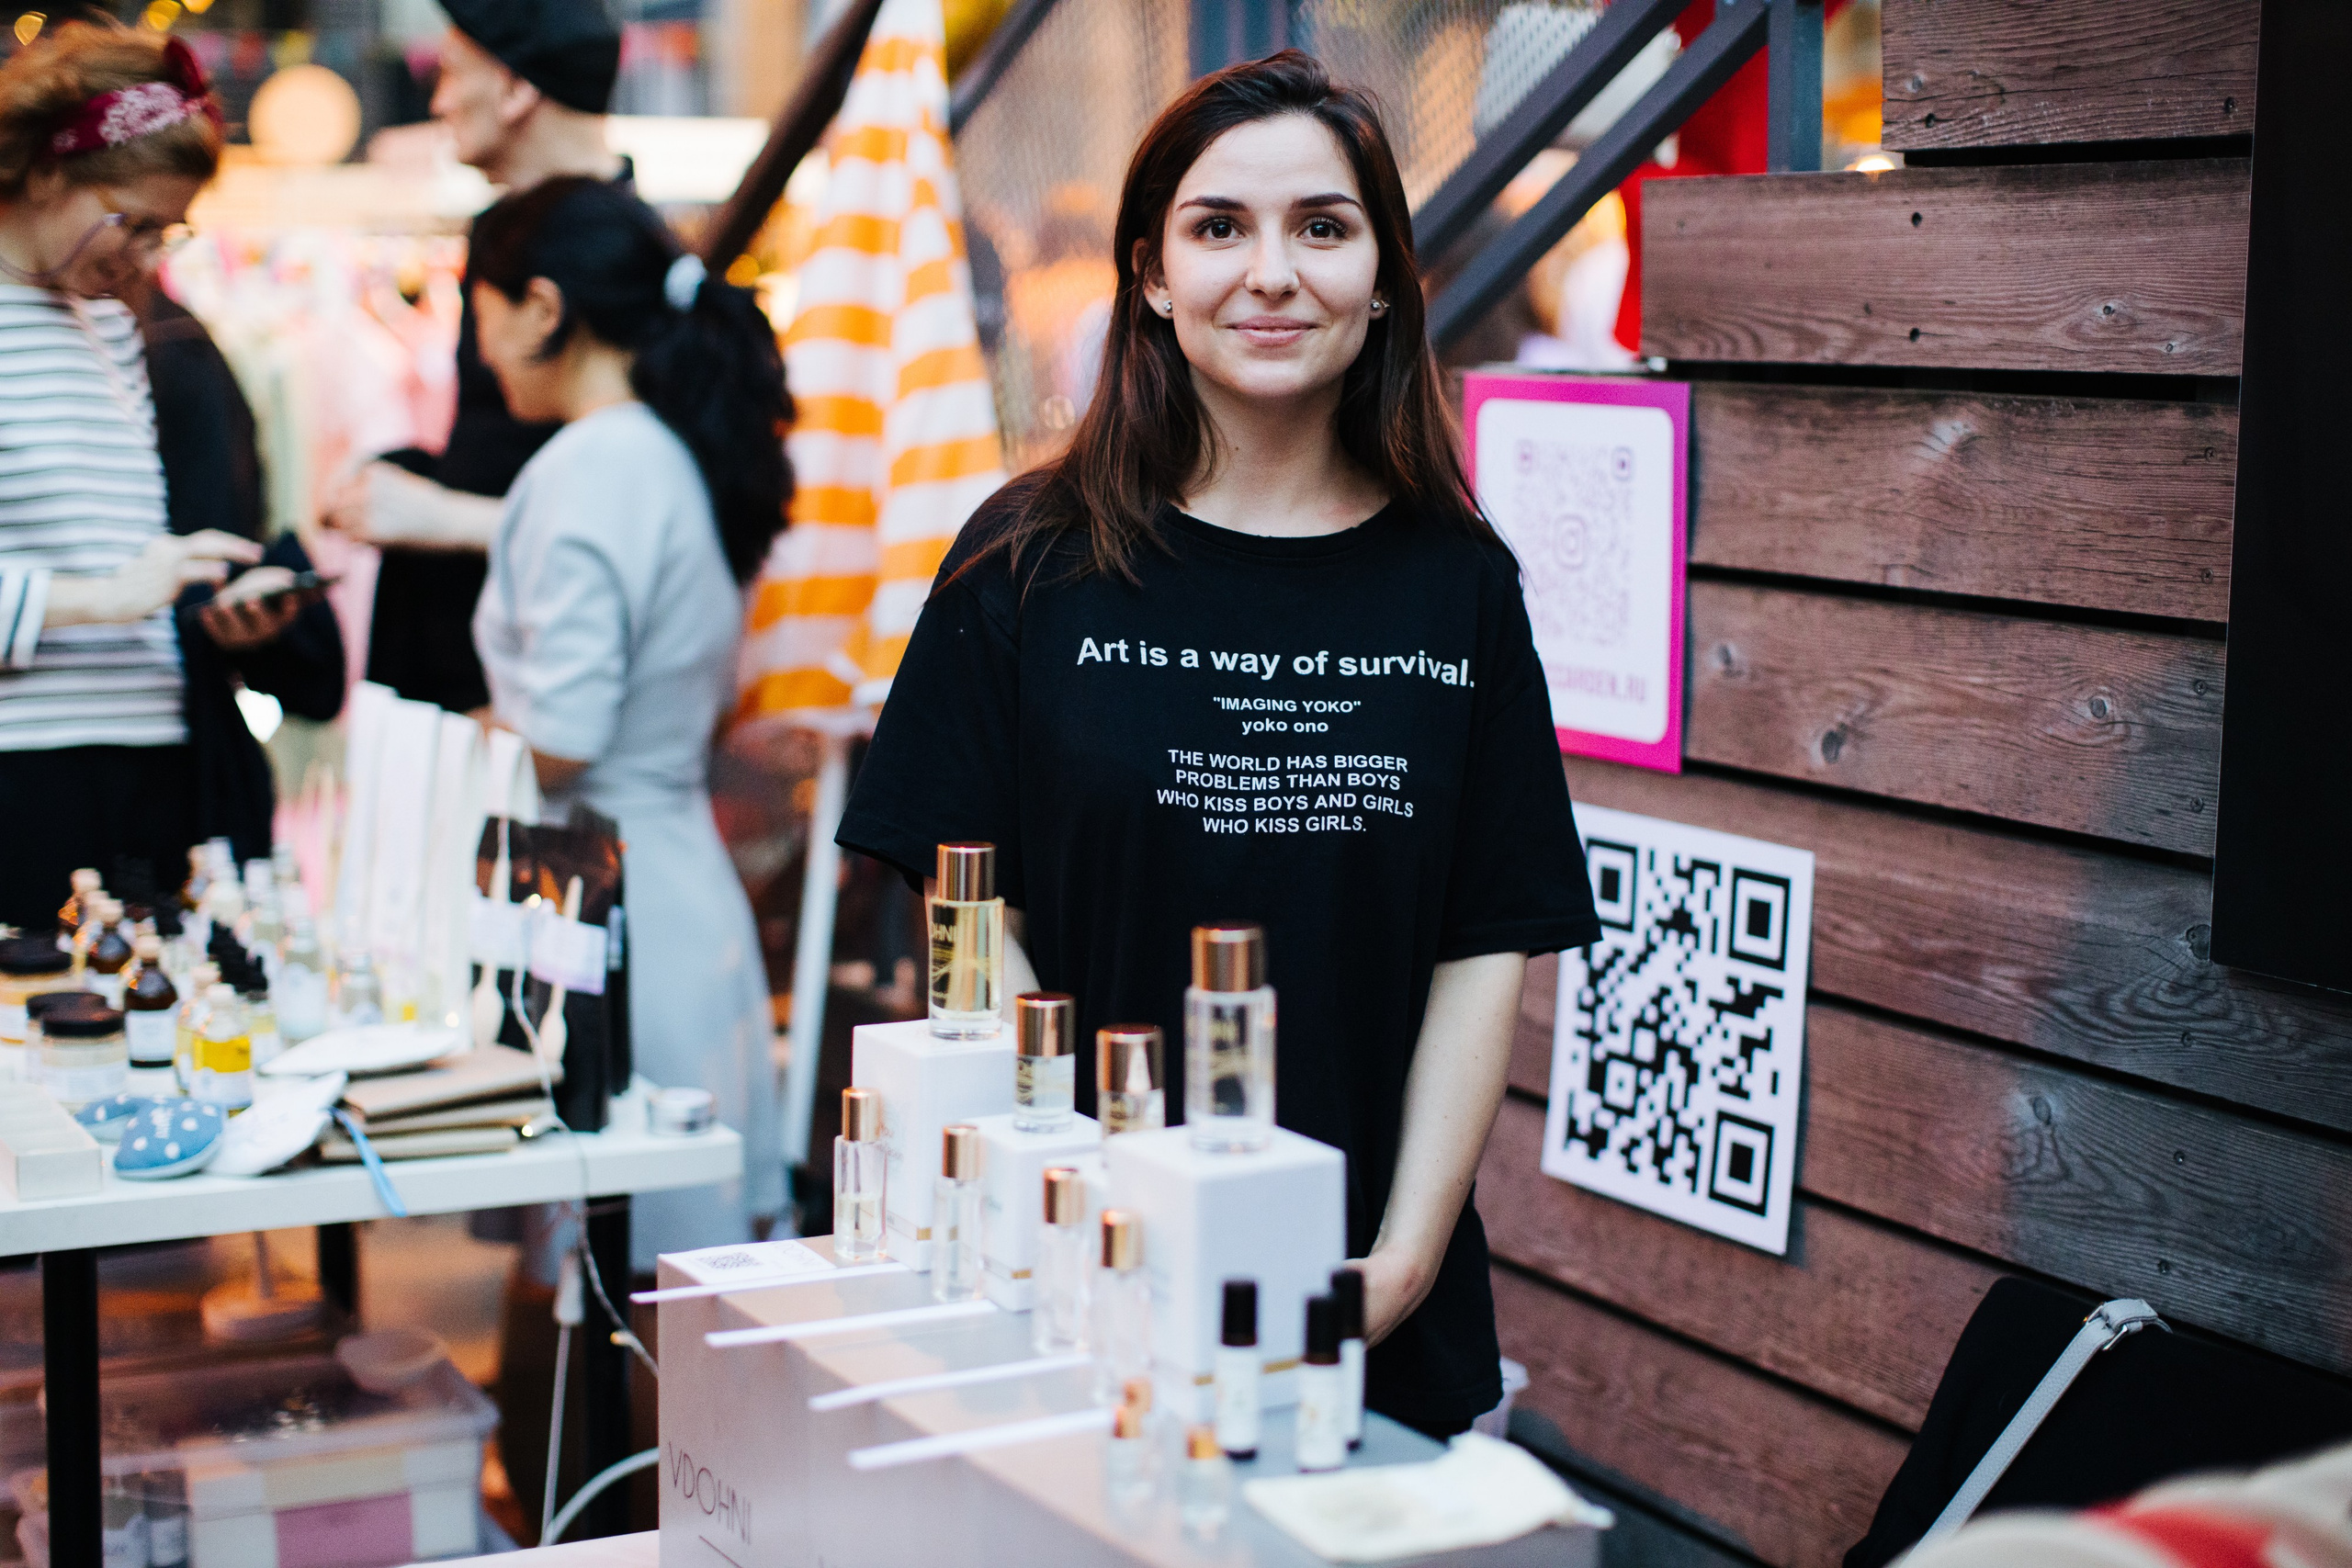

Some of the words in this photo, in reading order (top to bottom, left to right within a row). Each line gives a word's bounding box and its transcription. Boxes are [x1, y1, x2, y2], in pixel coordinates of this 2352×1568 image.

[1076, 637, 1130, 666] Art
[1139, 639, 1169, 667] is
[1180, 649, 1200, 669] a
[1209, 650, 1282, 681] way
[1293, 649, 1329, 675] of
[1338, 649, 1476, 689] survival.
[1213, 696, 1297, 713] "IMAGING
[1302, 700, 1363, 714] YOKO"
[1241, 717, 1288, 736] yoko
[1293, 721, 1329, 733] ono
[1167, 749, 1204, 767] THE
[1208, 752, 1281, 772] WORLD
[1286, 754, 1328, 770] HAS
[1334, 754, 1408, 773] BIGGER
[1175, 769, 1281, 791] PROBLEMS
[1285, 773, 1341, 788] THAN
[1347, 773, 1401, 791] BOYS
[1156, 789, 1199, 808] WHO
[1204, 795, 1248, 813] KISS
[1253, 795, 1309, 812] BOYS
[1314, 793, 1357, 809] AND
[1363, 794, 1415, 818] GIRLS
[1202, 817, 1249, 834] WHO
[1255, 817, 1300, 833] KISS
[1305, 815, 1367, 832] GIRLS.
[668, 1440, 752, 1546] VDOHNI
